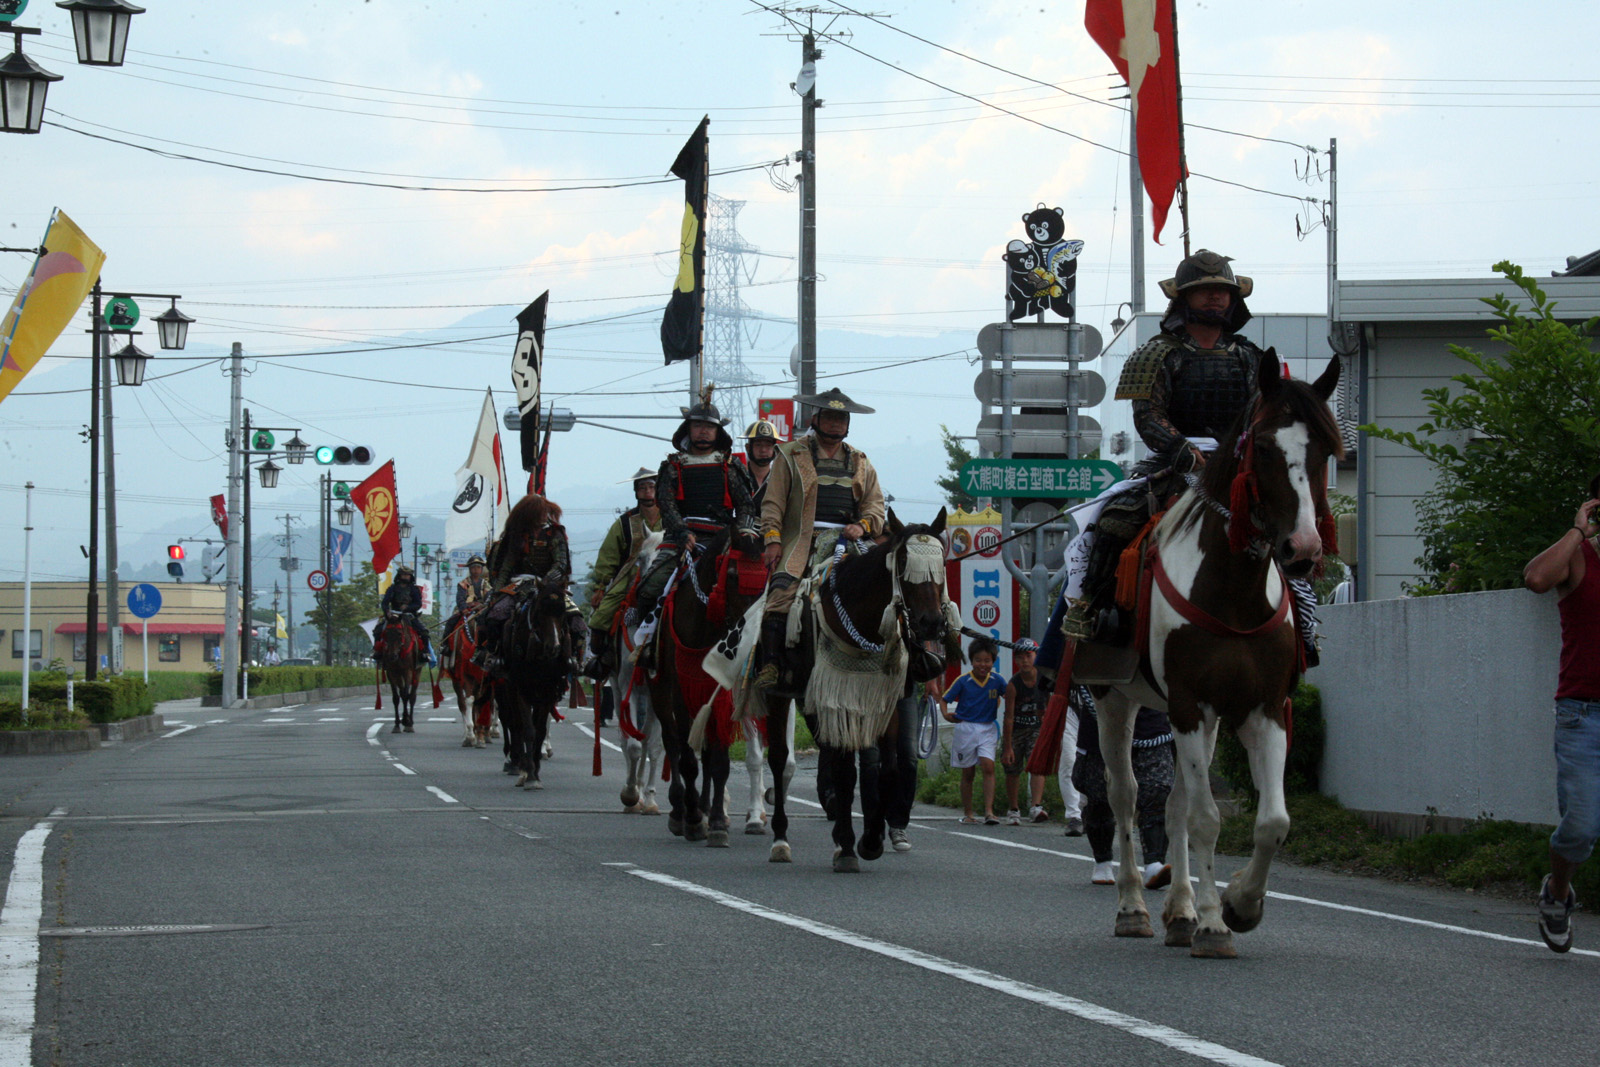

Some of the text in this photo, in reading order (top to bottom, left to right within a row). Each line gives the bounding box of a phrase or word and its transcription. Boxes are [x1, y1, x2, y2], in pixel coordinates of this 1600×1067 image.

[967, 465, 1092, 491] 大熊町複合型商工会館
[981, 536, 996, 548] 100
[312, 576, 324, 585] 50
[980, 608, 994, 619] 100
[988, 689, 998, 699] 10
